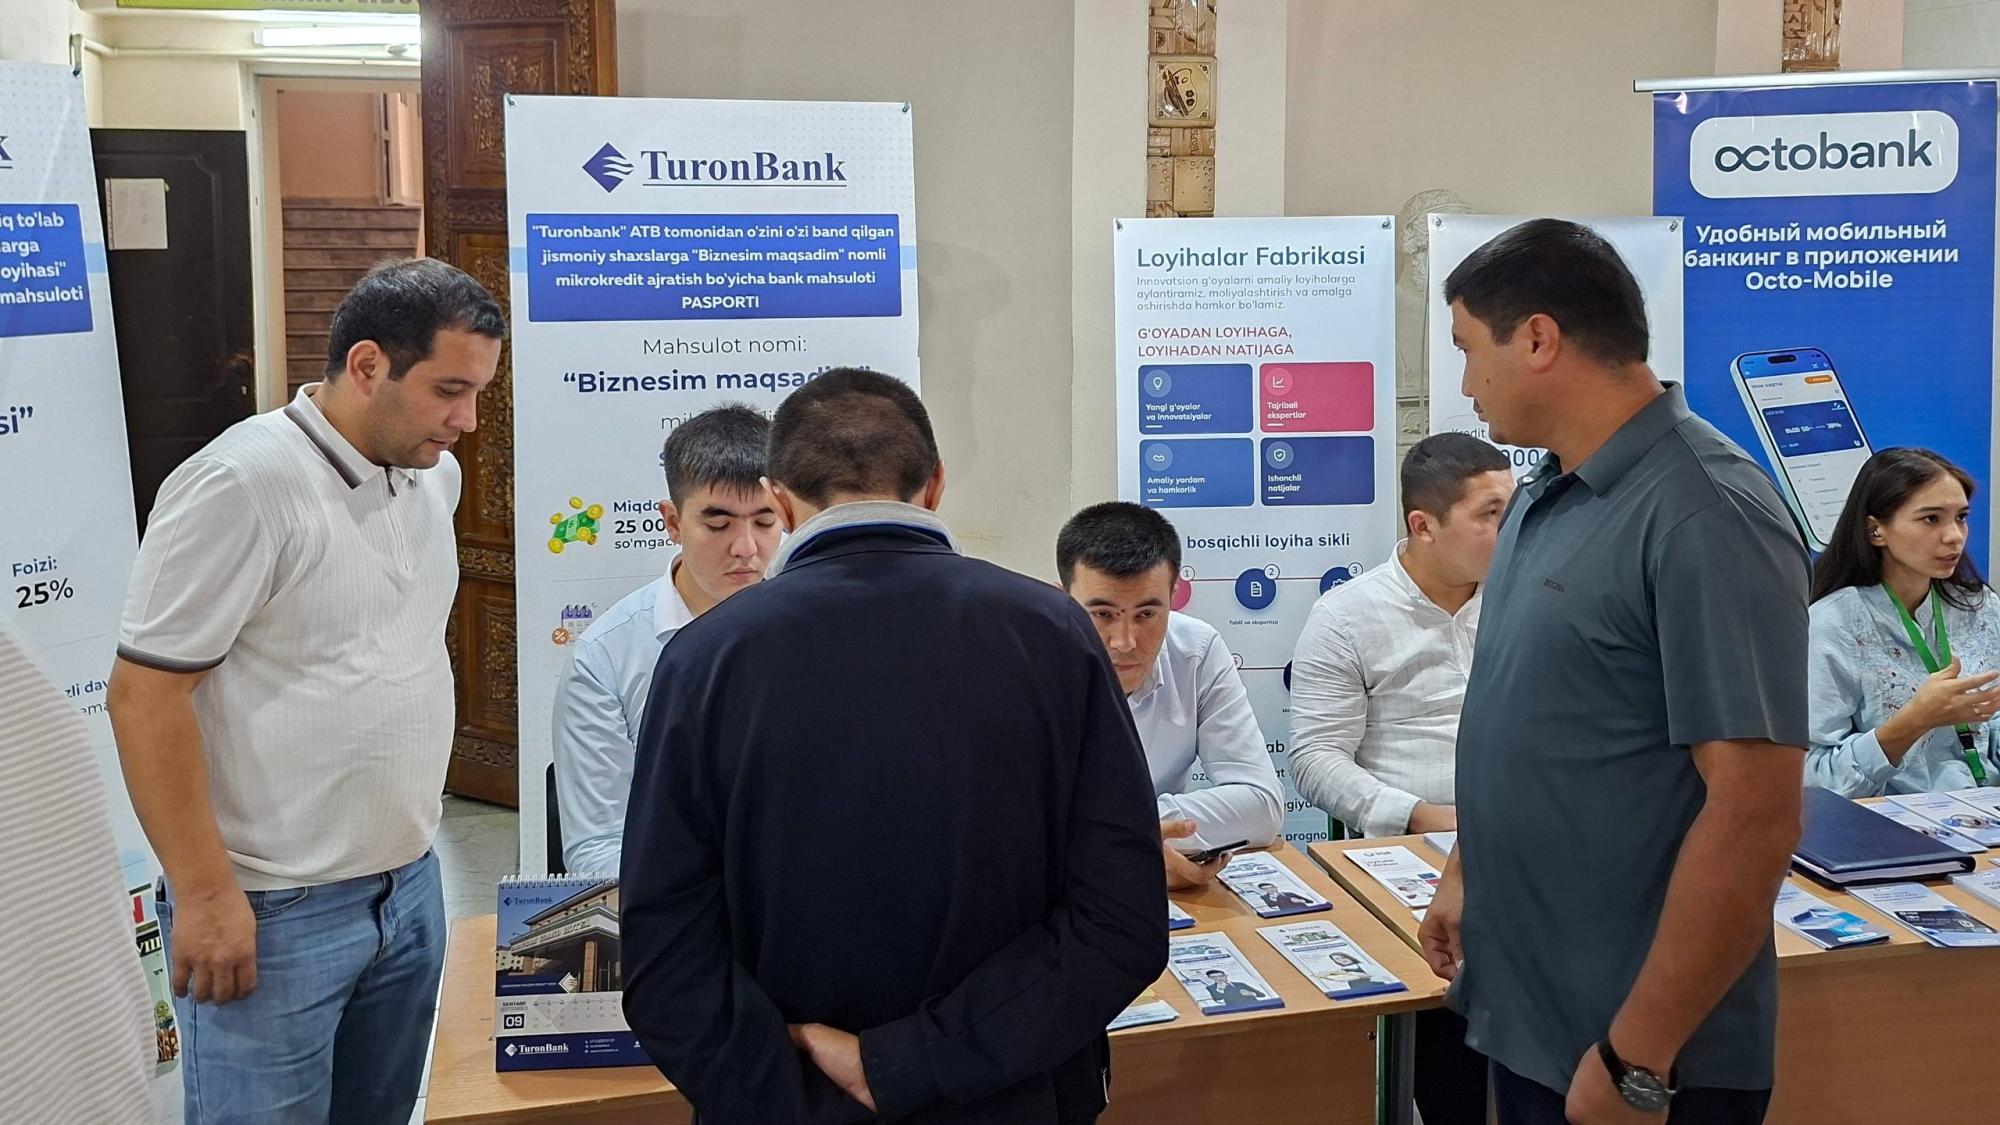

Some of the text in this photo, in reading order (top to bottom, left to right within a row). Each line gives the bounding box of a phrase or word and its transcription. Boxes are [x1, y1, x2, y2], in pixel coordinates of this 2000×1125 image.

[1714, 128, 1933, 173] octobank
[640, 150, 847, 182] TuronBank
[17, 211, 64, 228] to'lab
[532, 224, 894, 242] "Turonbank" ATB tomonidan o'zini o'zi band qilgan
[1696, 220, 1947, 245] Удобный мобильный
[541, 247, 887, 266] jismoniy shaxslarga "Biznesim maqsadim" nomli
[1137, 245, 1365, 272] Loyihalar Fabrikasi
[1685, 248, 1959, 269] банкинг в приложении
[555, 270, 876, 289] mikrokredit ajratish bo'yicha bank mahsuloti
[1137, 275, 1199, 286] Innovatsion
[1257, 274, 1293, 288] amaliy
[1295, 274, 1356, 287] loyihalarga
[1745, 270, 1893, 290] Octo-Mobile
[681, 295, 760, 309] PASPORTI
[1137, 287, 1352, 301] aylantiramiz, moliyalashtirish va amalga
[1137, 301, 1192, 311] oshirishda
[1195, 300, 1235, 310] hamkor
[1216, 326, 1292, 340] LOYIHAGA,
[643, 336, 807, 355] Mahsulot nomi:
[1138, 344, 1294, 358] LOYIHADAN NATIJAGA
[563, 370, 707, 393] “Biznesim
[1147, 475, 1205, 486] Amaliy yardam
[1267, 474, 1302, 483] Ishonchli
[614, 520, 637, 534] 25
[1187, 533, 1350, 551] bosqichli loyiha sikli
[12, 556, 57, 577] Foizi:
[1184, 569, 1190, 578] 1
[1268, 568, 1275, 576] 2
[1352, 566, 1358, 574] 3
[16, 577, 74, 609] 25%
[505, 1015, 523, 1028] 09
[519, 1043, 569, 1053] TuronBank
